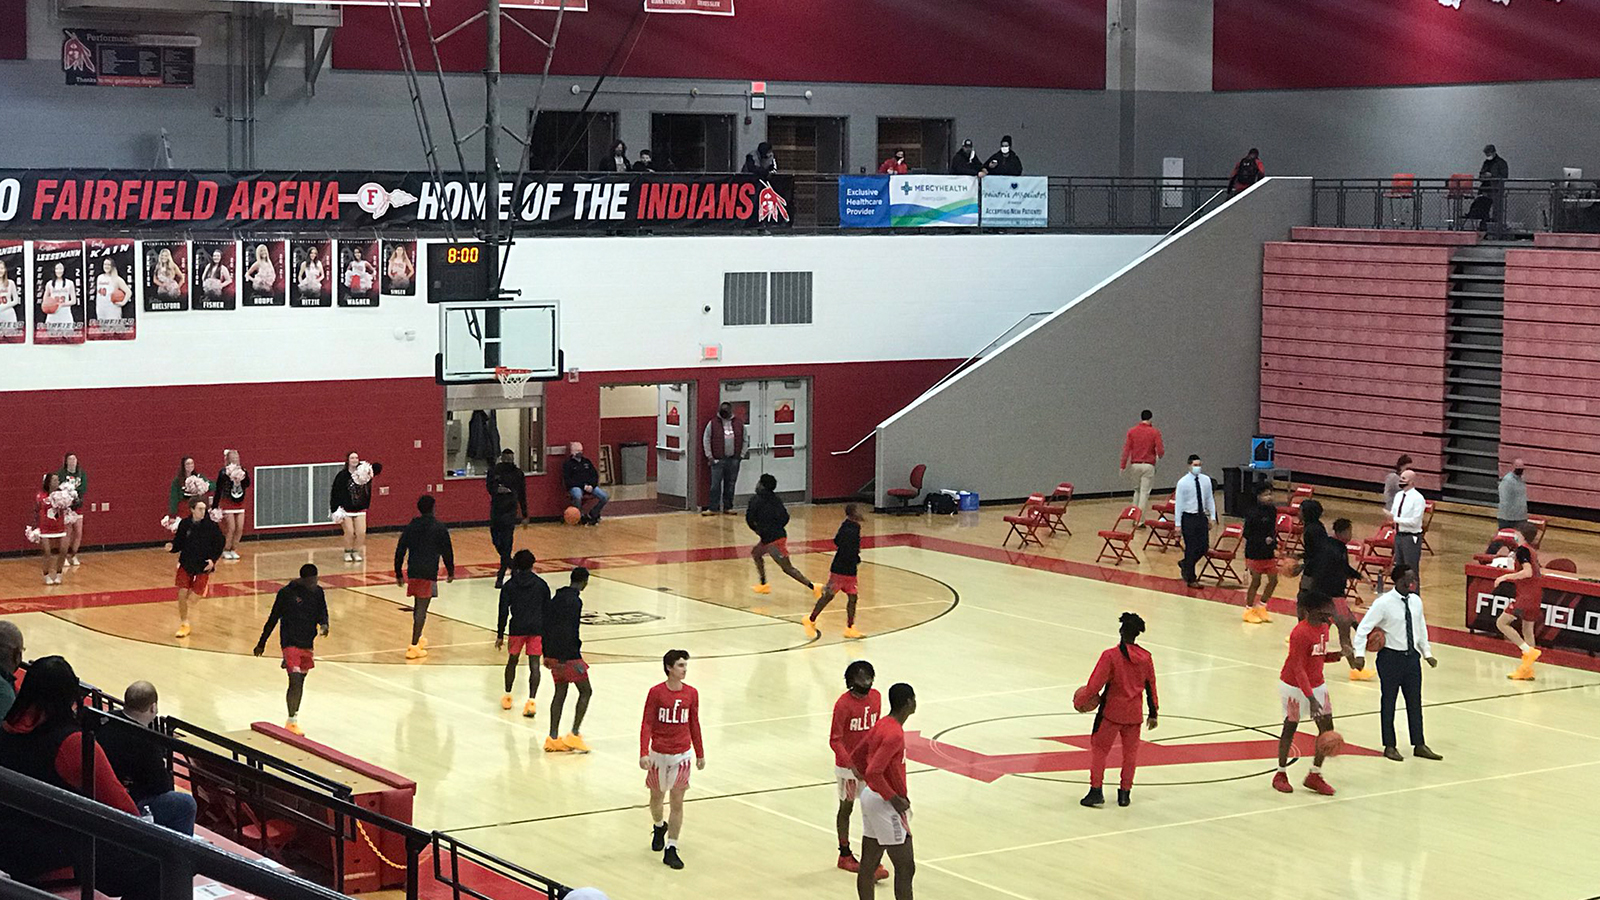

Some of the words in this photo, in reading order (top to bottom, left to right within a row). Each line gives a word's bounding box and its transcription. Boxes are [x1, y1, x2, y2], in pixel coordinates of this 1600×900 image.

[846, 188, 879, 196] Exclusive
[915, 184, 968, 192] MERCYHEALTH
[32, 180, 219, 220] FAIRFIELD
[225, 180, 340, 220] ARENA
[417, 181, 513, 221] HOME
[520, 182, 564, 221] OF
[573, 183, 630, 221] THE
[636, 183, 756, 220] INDIANS
[846, 198, 882, 206] Healthcare
[846, 207, 875, 215] Provider
[89, 244, 129, 258] KAIN
[448, 247, 479, 263] 8:00
[202, 301, 225, 309] FISHER
[347, 298, 371, 306] WAGNER
[1128, 507, 1136, 517] F
[1277, 515, 1286, 525] F
[1384, 530, 1393, 540] F
